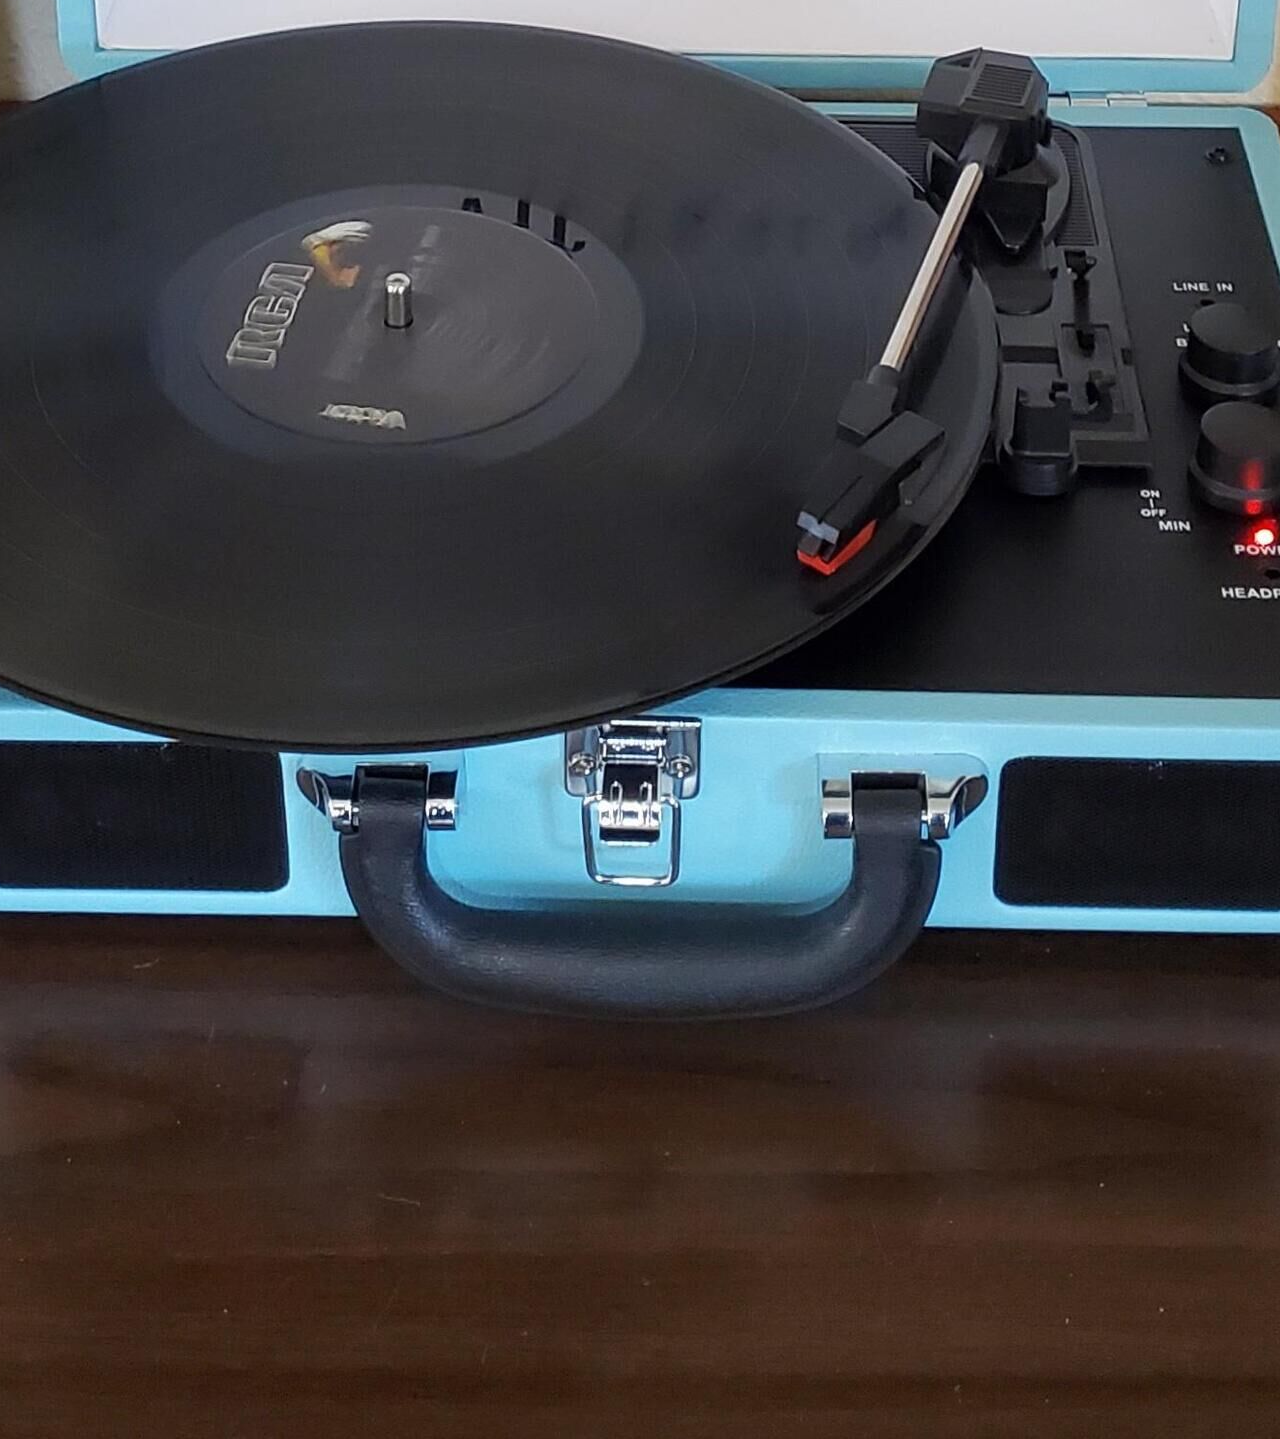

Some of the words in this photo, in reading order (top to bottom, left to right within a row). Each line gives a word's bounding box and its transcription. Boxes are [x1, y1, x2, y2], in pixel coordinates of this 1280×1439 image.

[1172, 282, 1210, 292] LINE
[1216, 282, 1234, 292] IN
[1140, 489, 1160, 499] ON
[1140, 507, 1166, 517] OFF
[1158, 520, 1192, 532] MIN
